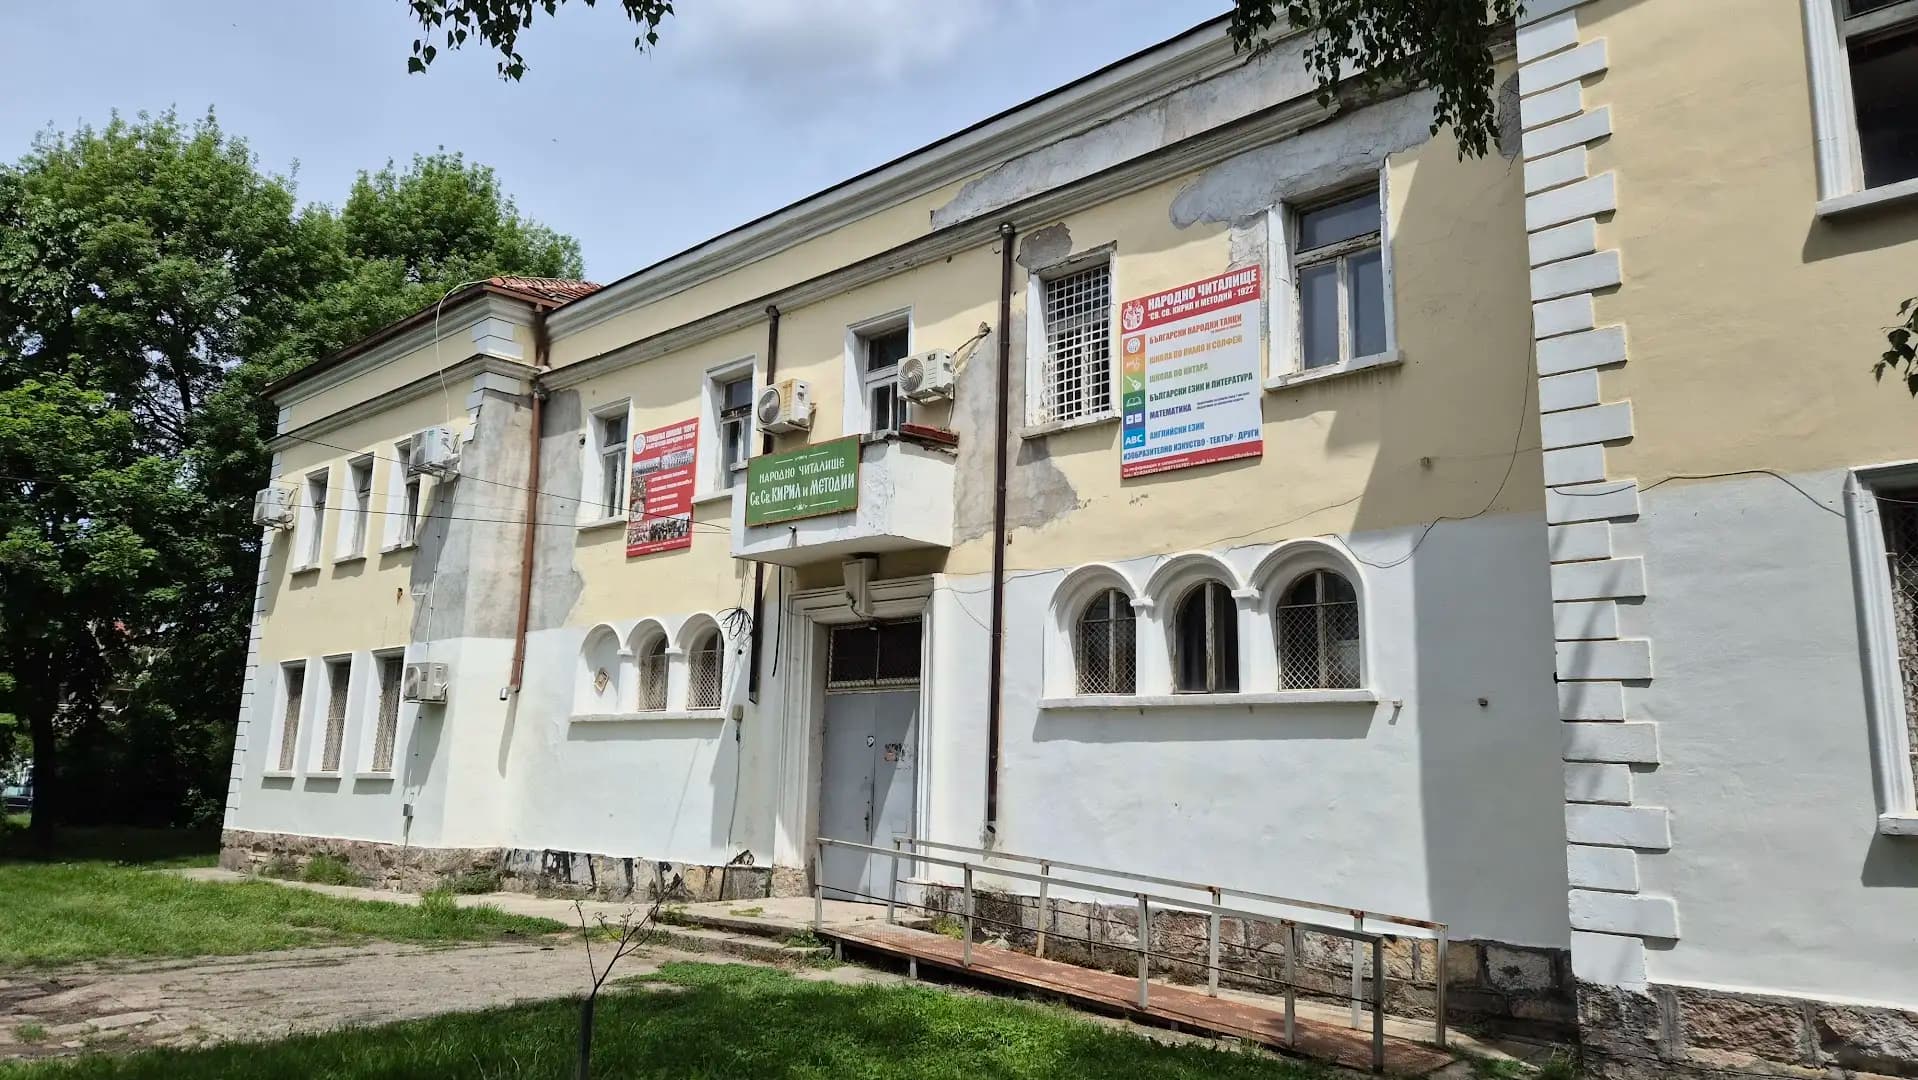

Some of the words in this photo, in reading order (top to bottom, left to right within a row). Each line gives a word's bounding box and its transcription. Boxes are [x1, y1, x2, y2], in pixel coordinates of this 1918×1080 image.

[1148, 287, 1196, 311] НАРОДНО
[1198, 269, 1257, 297] ЧИТАЛИЩЕ
[1173, 303, 1194, 315] КИРИЛ
[1201, 292, 1233, 306] МЕТОДИЙ
[1150, 328, 1187, 344] БЪЛГАРСКИ
[1188, 320, 1219, 336] НАРОДНИ
[1220, 314, 1242, 327] ТАНЦИ
[1150, 353, 1173, 364] ШКОЛА
[1174, 349, 1182, 359] ПО
[1184, 342, 1206, 356] ПИАНО
[1212, 335, 1243, 350] СОЛФЕЖ
[1150, 370, 1173, 383] ШКОЛА
[1174, 367, 1182, 378] ПО
[1184, 362, 1208, 376] КИТАРА
[1150, 386, 1187, 402] БЪЛГАРСКИ
[1188, 382, 1205, 394] ЕЗИК
[1206, 381, 1210, 390] И
[1211, 372, 1253, 388] ЛИТЕРАТУРА
[1150, 404, 1192, 420] МАТЕМАТИКА
[1188, 422, 1205, 432] ЕЗИК
[1124, 445, 1172, 460] ИЗОБРАЗИТЕЛНО
[1210, 434, 1234, 445] ТЕАТЪР
[1237, 428, 1259, 440] ДРУГИ
[1126, 434, 1144, 446] ABC
[760, 467, 796, 484] НАРОДНО
[772, 483, 800, 502] КИРИЛ
